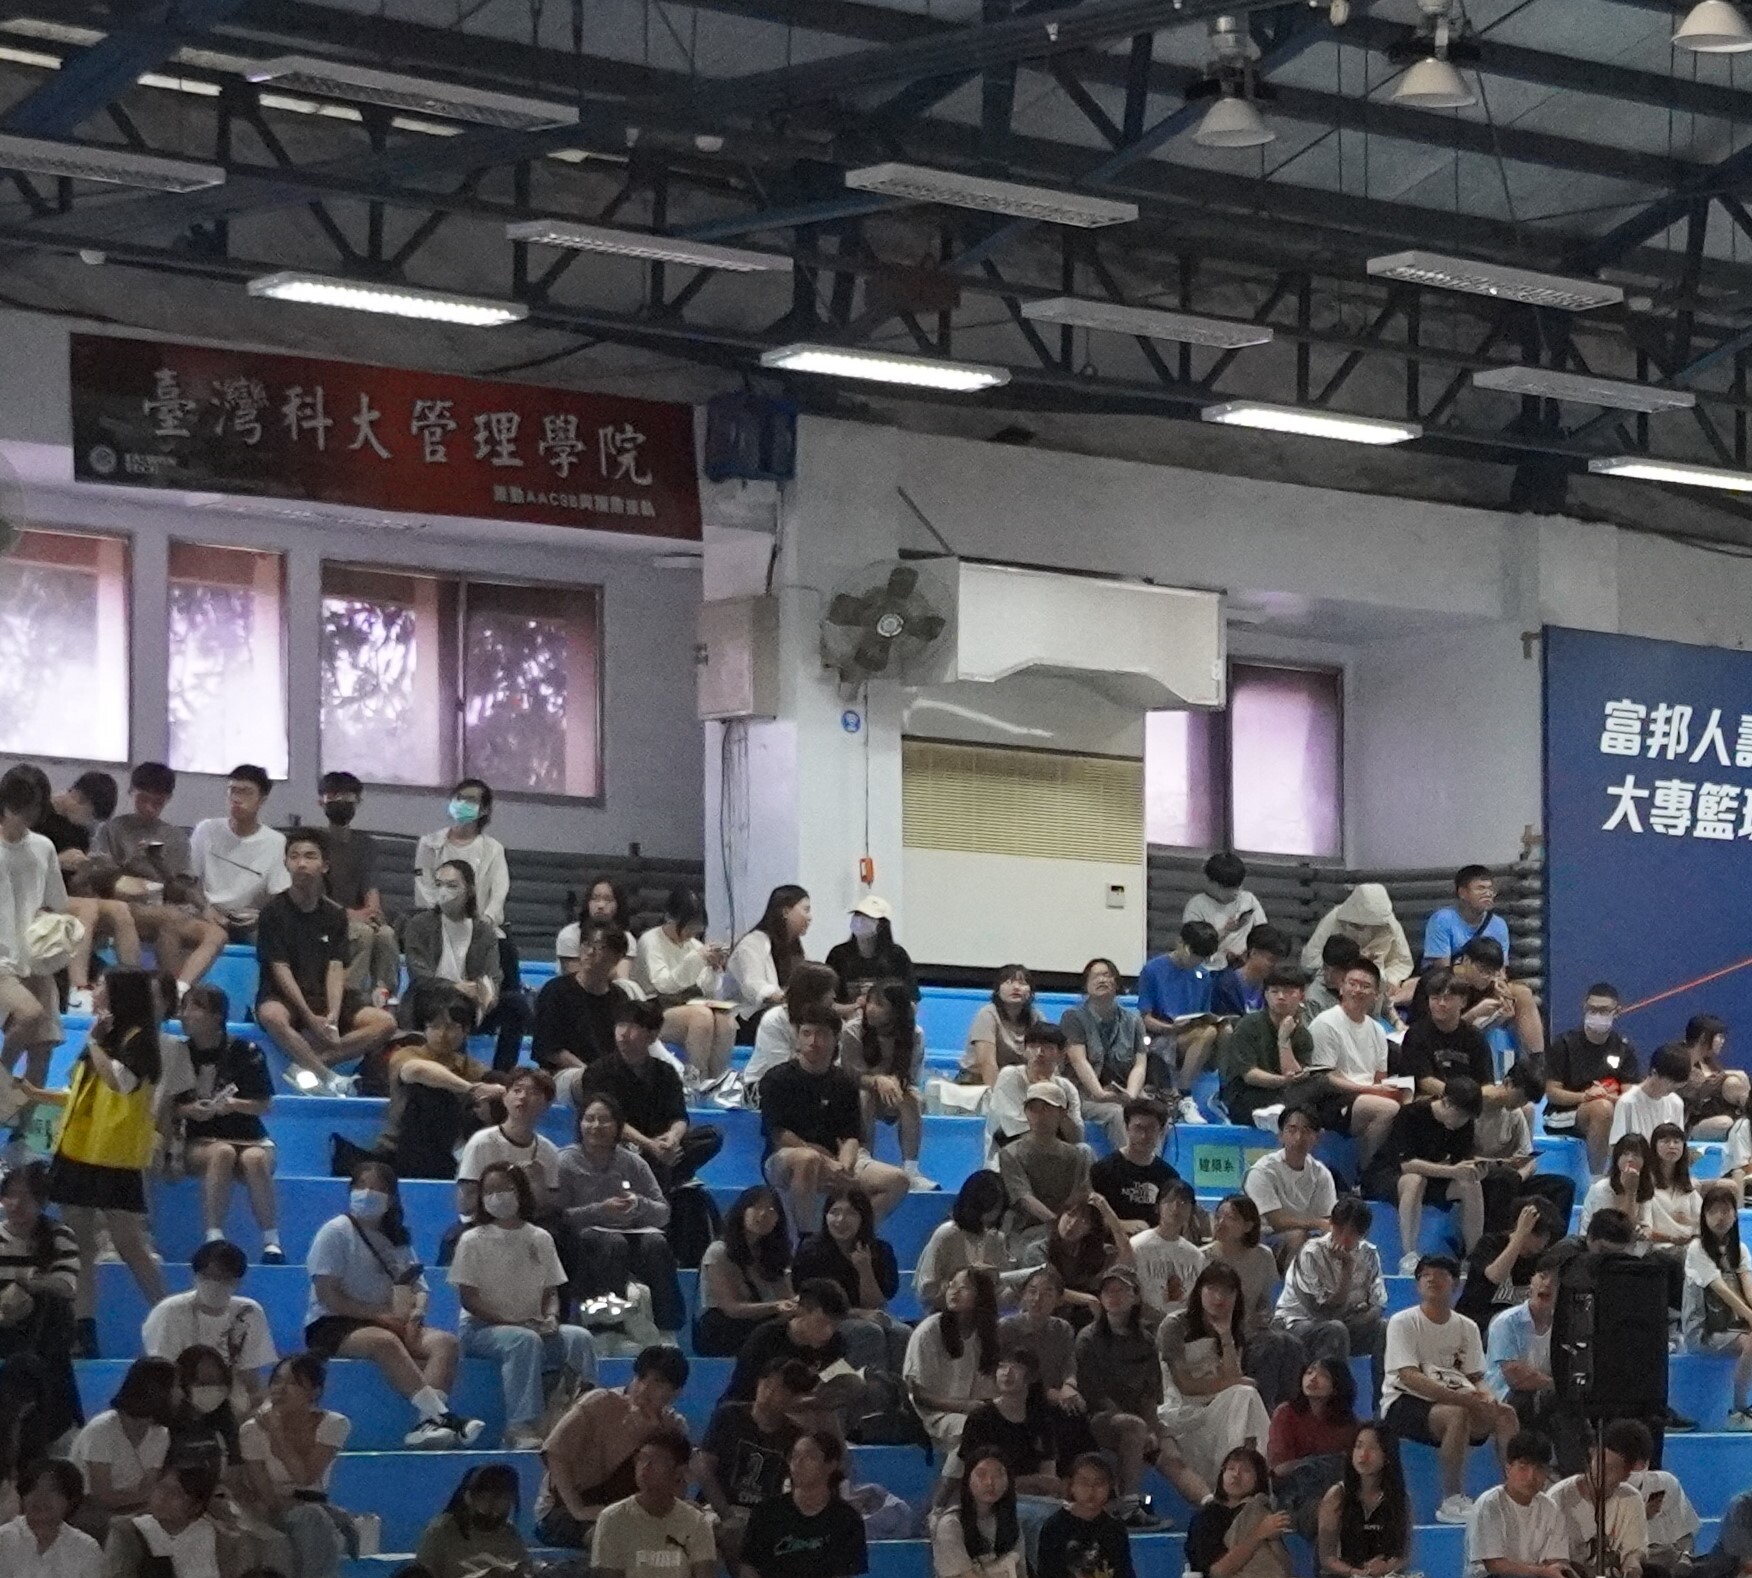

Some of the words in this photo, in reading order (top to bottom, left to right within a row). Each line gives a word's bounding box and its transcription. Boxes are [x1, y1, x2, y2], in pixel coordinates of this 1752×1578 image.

[143, 368, 653, 486] 臺灣科大管理學院
